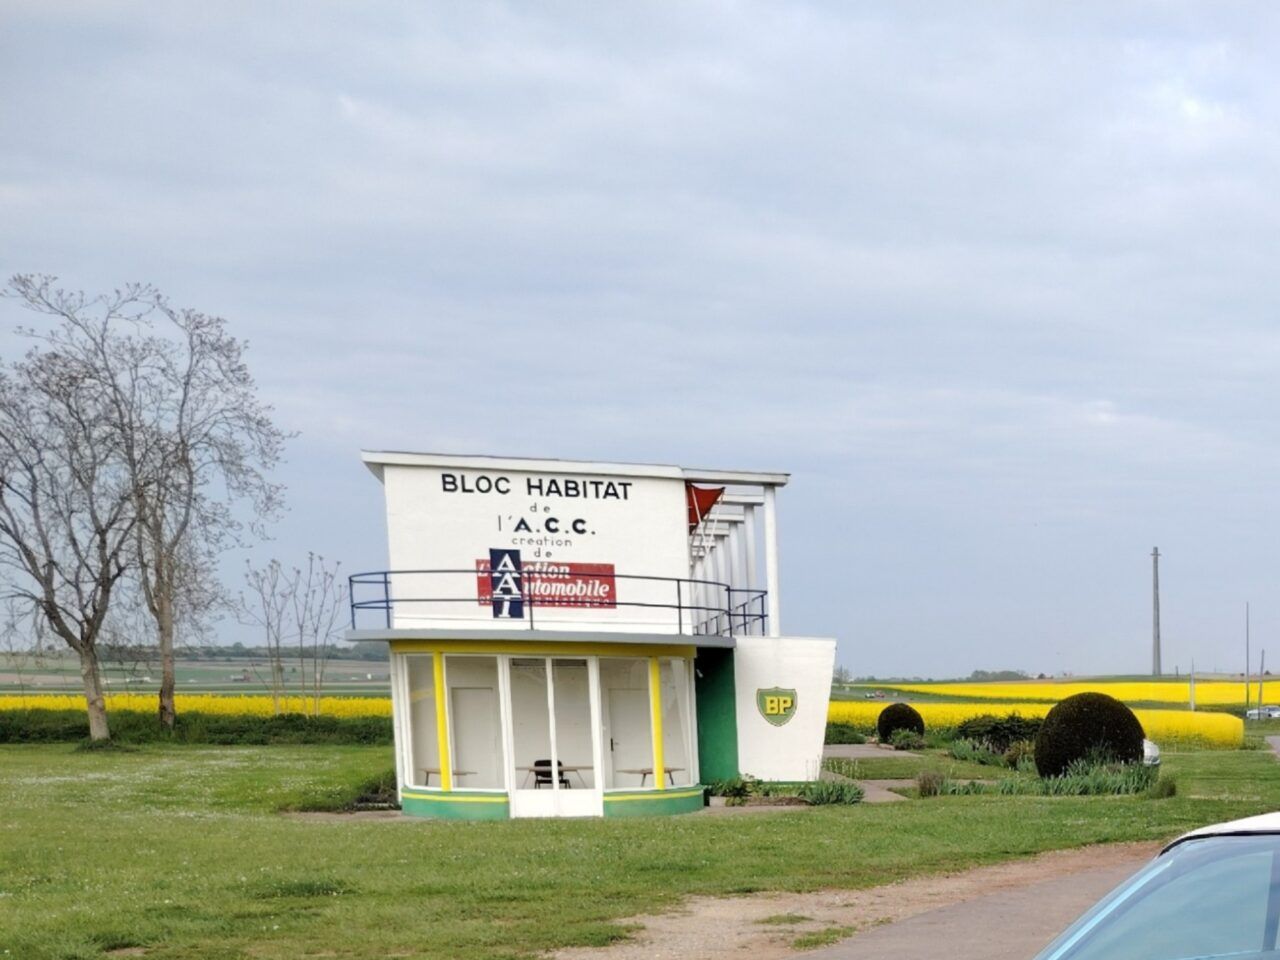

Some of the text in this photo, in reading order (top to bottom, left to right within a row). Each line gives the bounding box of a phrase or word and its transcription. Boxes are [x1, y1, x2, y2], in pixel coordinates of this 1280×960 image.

[441, 473, 632, 500] BLOC HABITAT
[529, 502, 551, 513] de
[534, 547, 553, 558] de
[765, 696, 793, 715] BP
